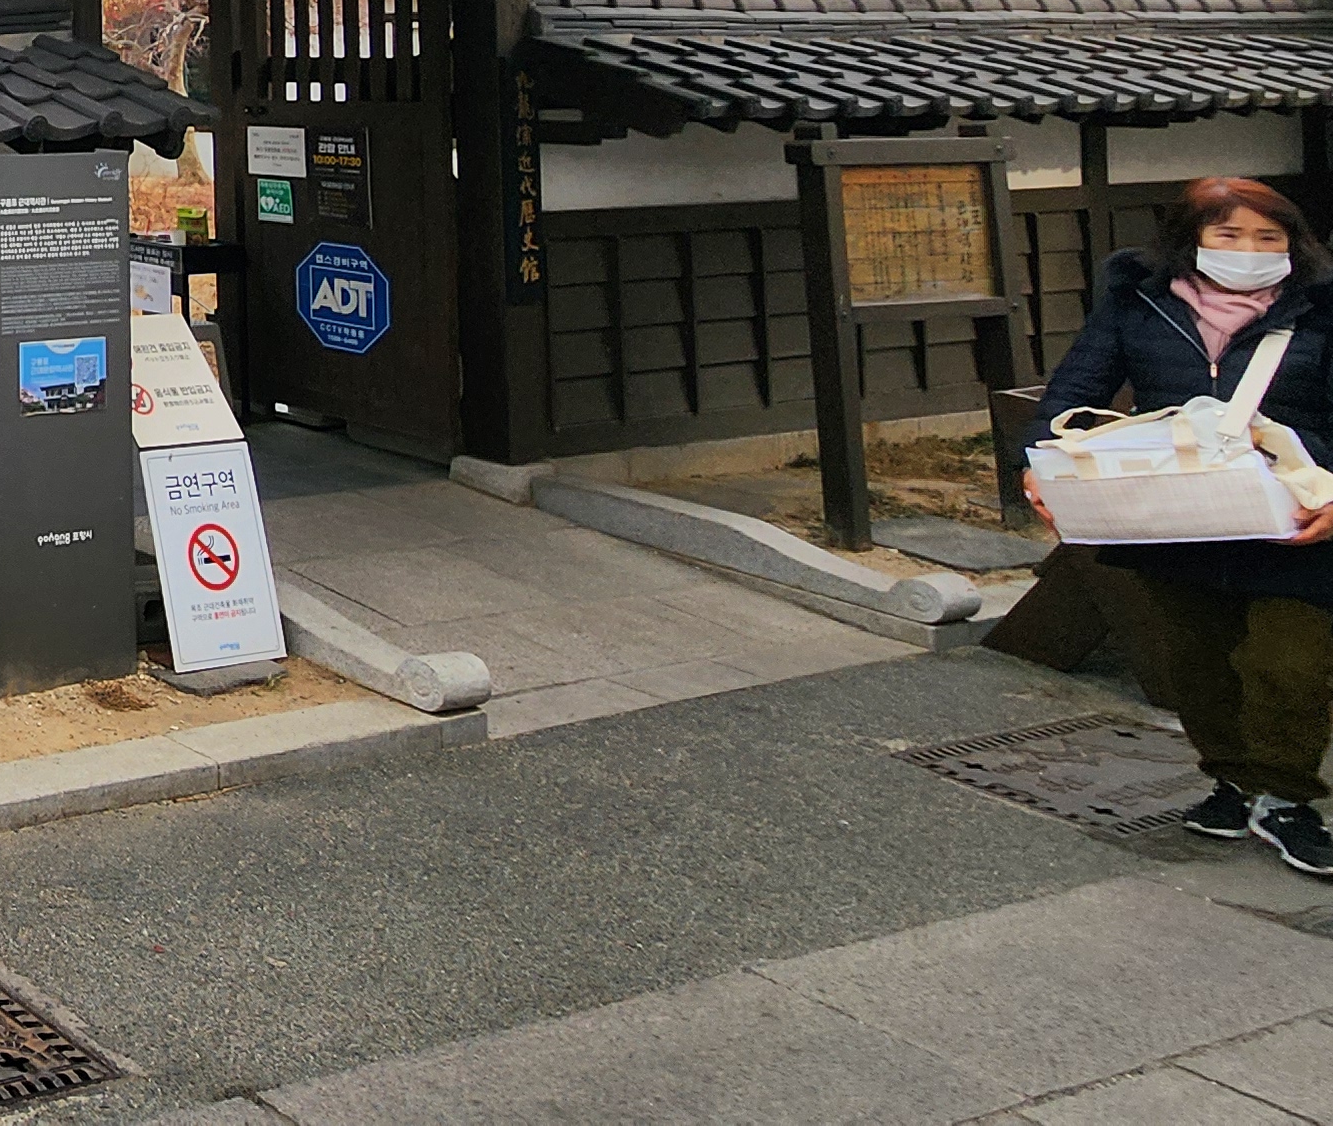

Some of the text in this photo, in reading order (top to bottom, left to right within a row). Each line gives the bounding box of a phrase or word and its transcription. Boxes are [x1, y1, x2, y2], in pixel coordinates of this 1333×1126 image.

[311, 276, 374, 318] ADT
[165, 469, 237, 500] 금연구역
[169, 500, 240, 516] No Smoking Area
